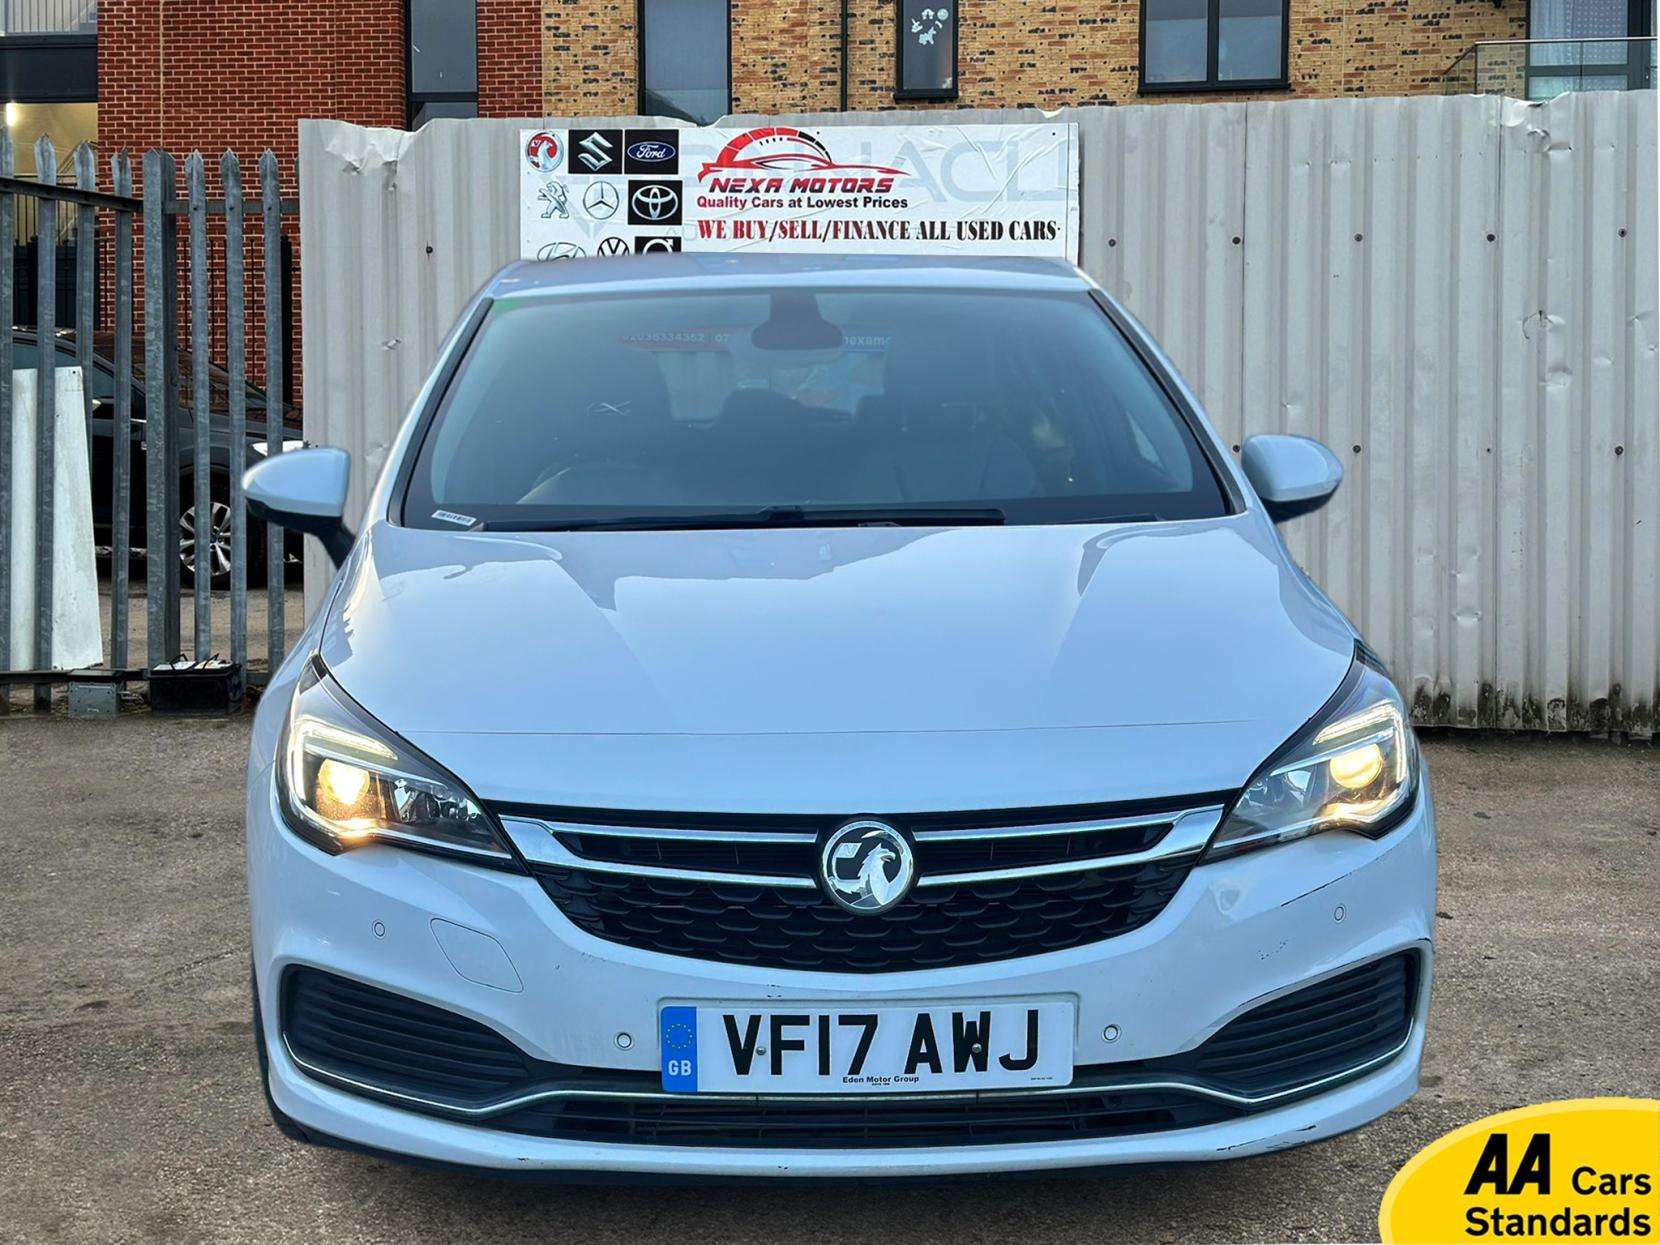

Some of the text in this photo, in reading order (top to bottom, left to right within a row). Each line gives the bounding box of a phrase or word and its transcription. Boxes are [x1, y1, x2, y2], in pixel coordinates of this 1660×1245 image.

[636, 144, 666, 158] Ford
[709, 177, 894, 194] NEXA MOTORS
[697, 196, 908, 211] Quality Cars at Lowest Prices
[697, 219, 727, 240] WE
[732, 219, 911, 243] BUY/SELL/FINANCE
[916, 220, 951, 241] ALL
[956, 220, 1004, 241] USED
[722, 1009, 1039, 1076] VF17 AWJ
[667, 1059, 693, 1077] GB
[866, 1075, 892, 1083] Motor
[893, 1075, 920, 1083] Group
